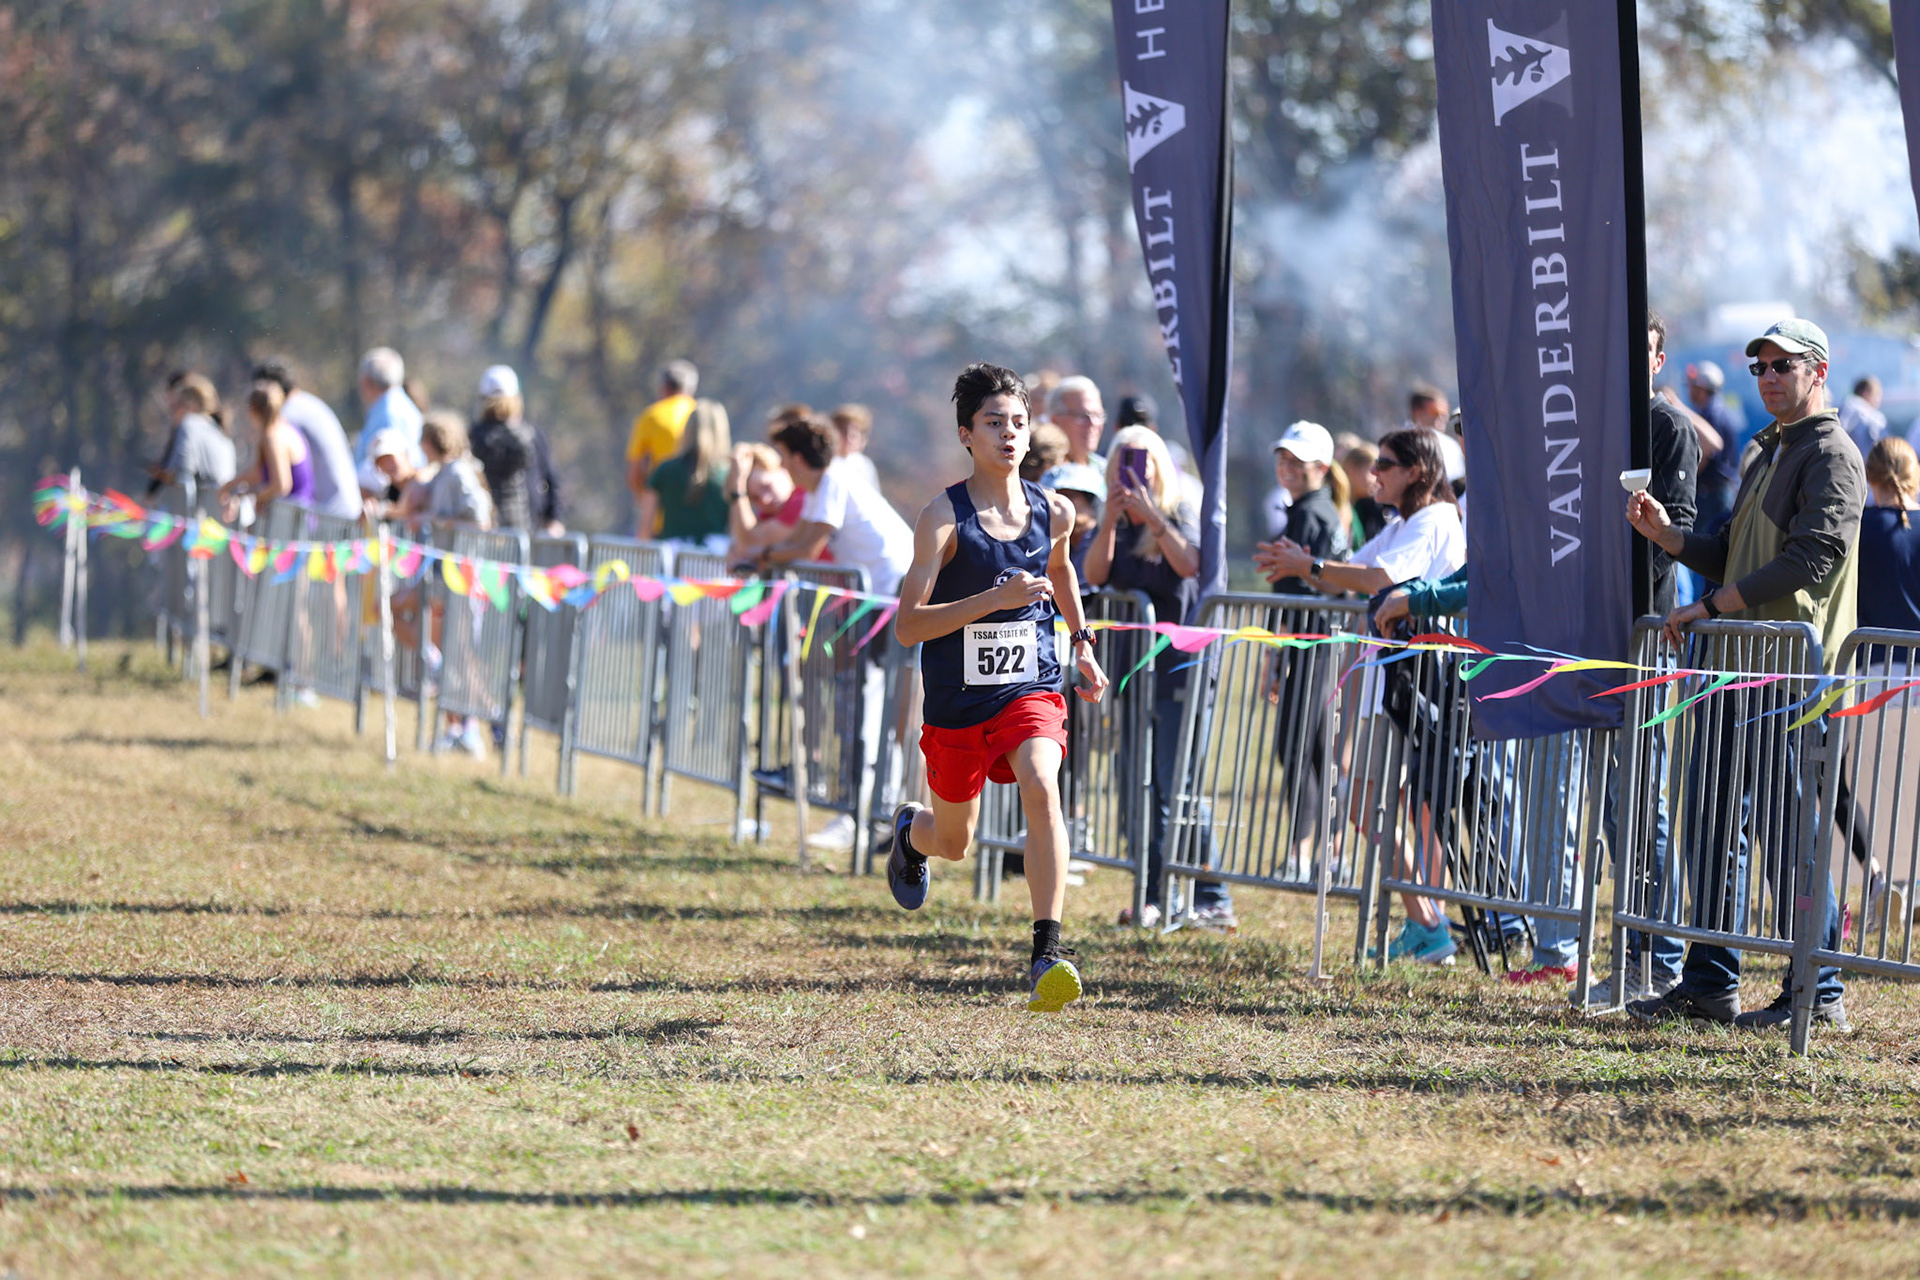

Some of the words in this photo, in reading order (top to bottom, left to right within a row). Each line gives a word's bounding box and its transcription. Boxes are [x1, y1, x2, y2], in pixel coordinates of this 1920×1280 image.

[1521, 143, 1582, 567] VANDERBILT
[973, 631, 998, 640] TSSAA
[998, 629, 1018, 639] STATE
[978, 645, 1025, 676] 522
